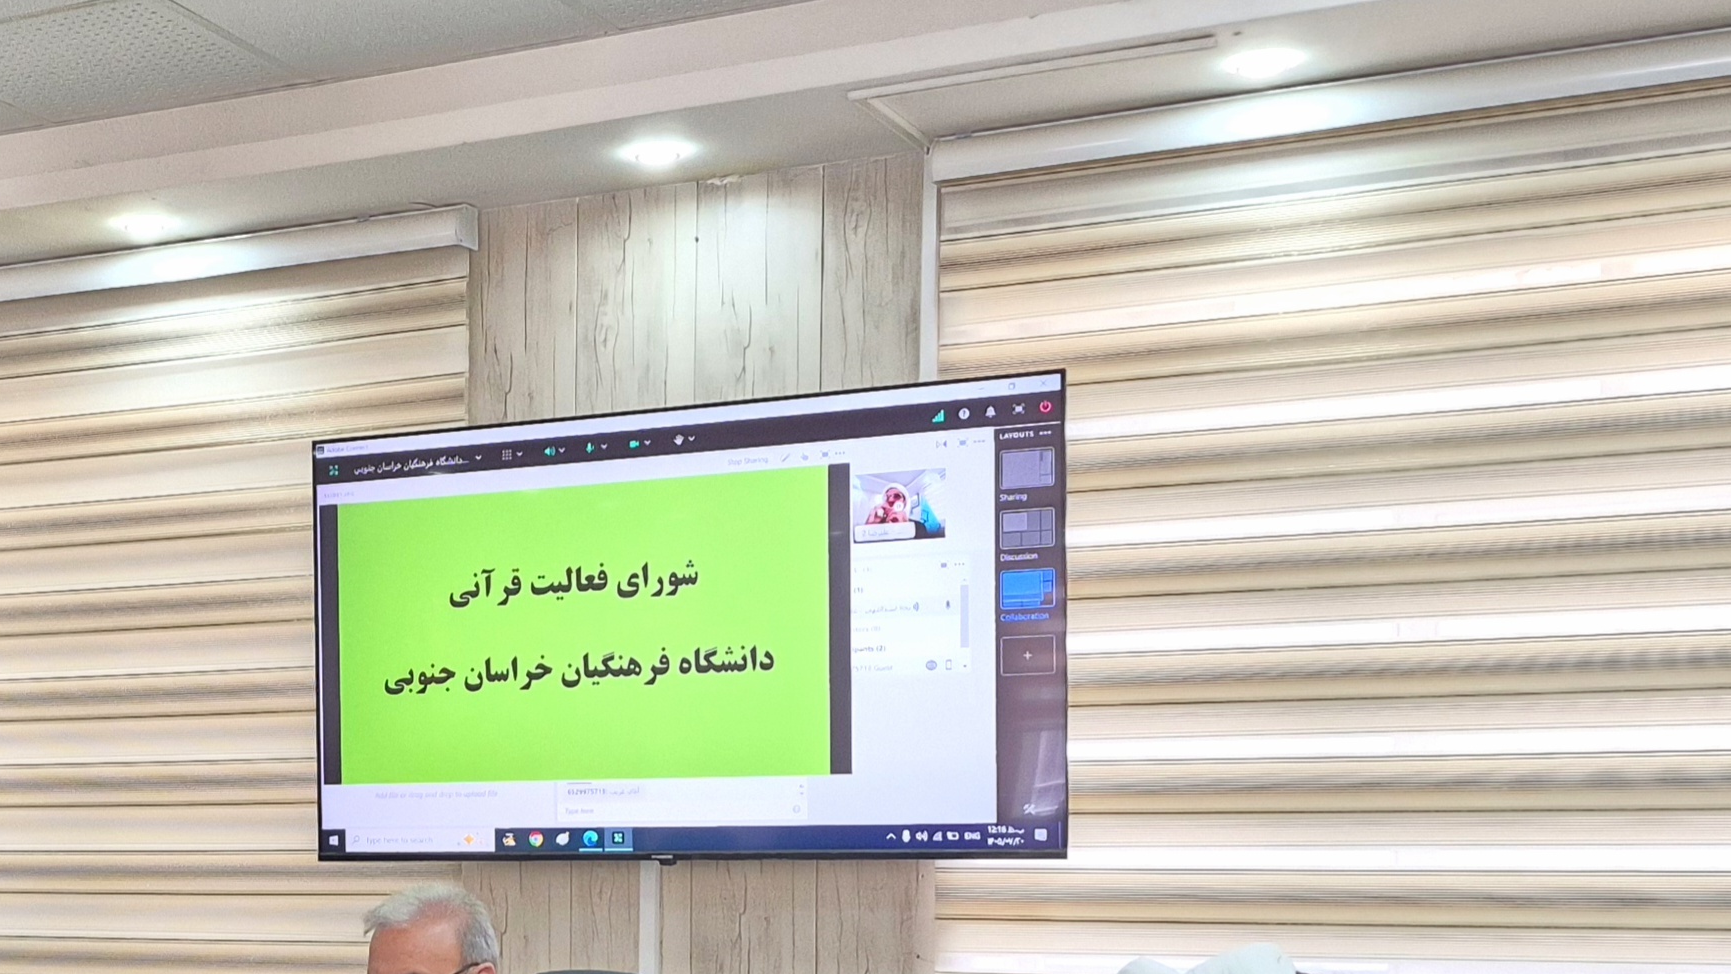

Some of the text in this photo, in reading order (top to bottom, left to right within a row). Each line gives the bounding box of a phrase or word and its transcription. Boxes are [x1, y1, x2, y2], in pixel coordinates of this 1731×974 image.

[999, 430, 1034, 440] LAYOUTS
[377, 460, 402, 473] خراسان
[999, 493, 1027, 502] Sharing
[1000, 552, 1039, 562] Discussion
[449, 559, 699, 608] شورای فعالیت قرآنی
[1000, 612, 1049, 622] Collaboration
[384, 644, 775, 696] دانشگاه فرهنگیان خراسان جنوبی
